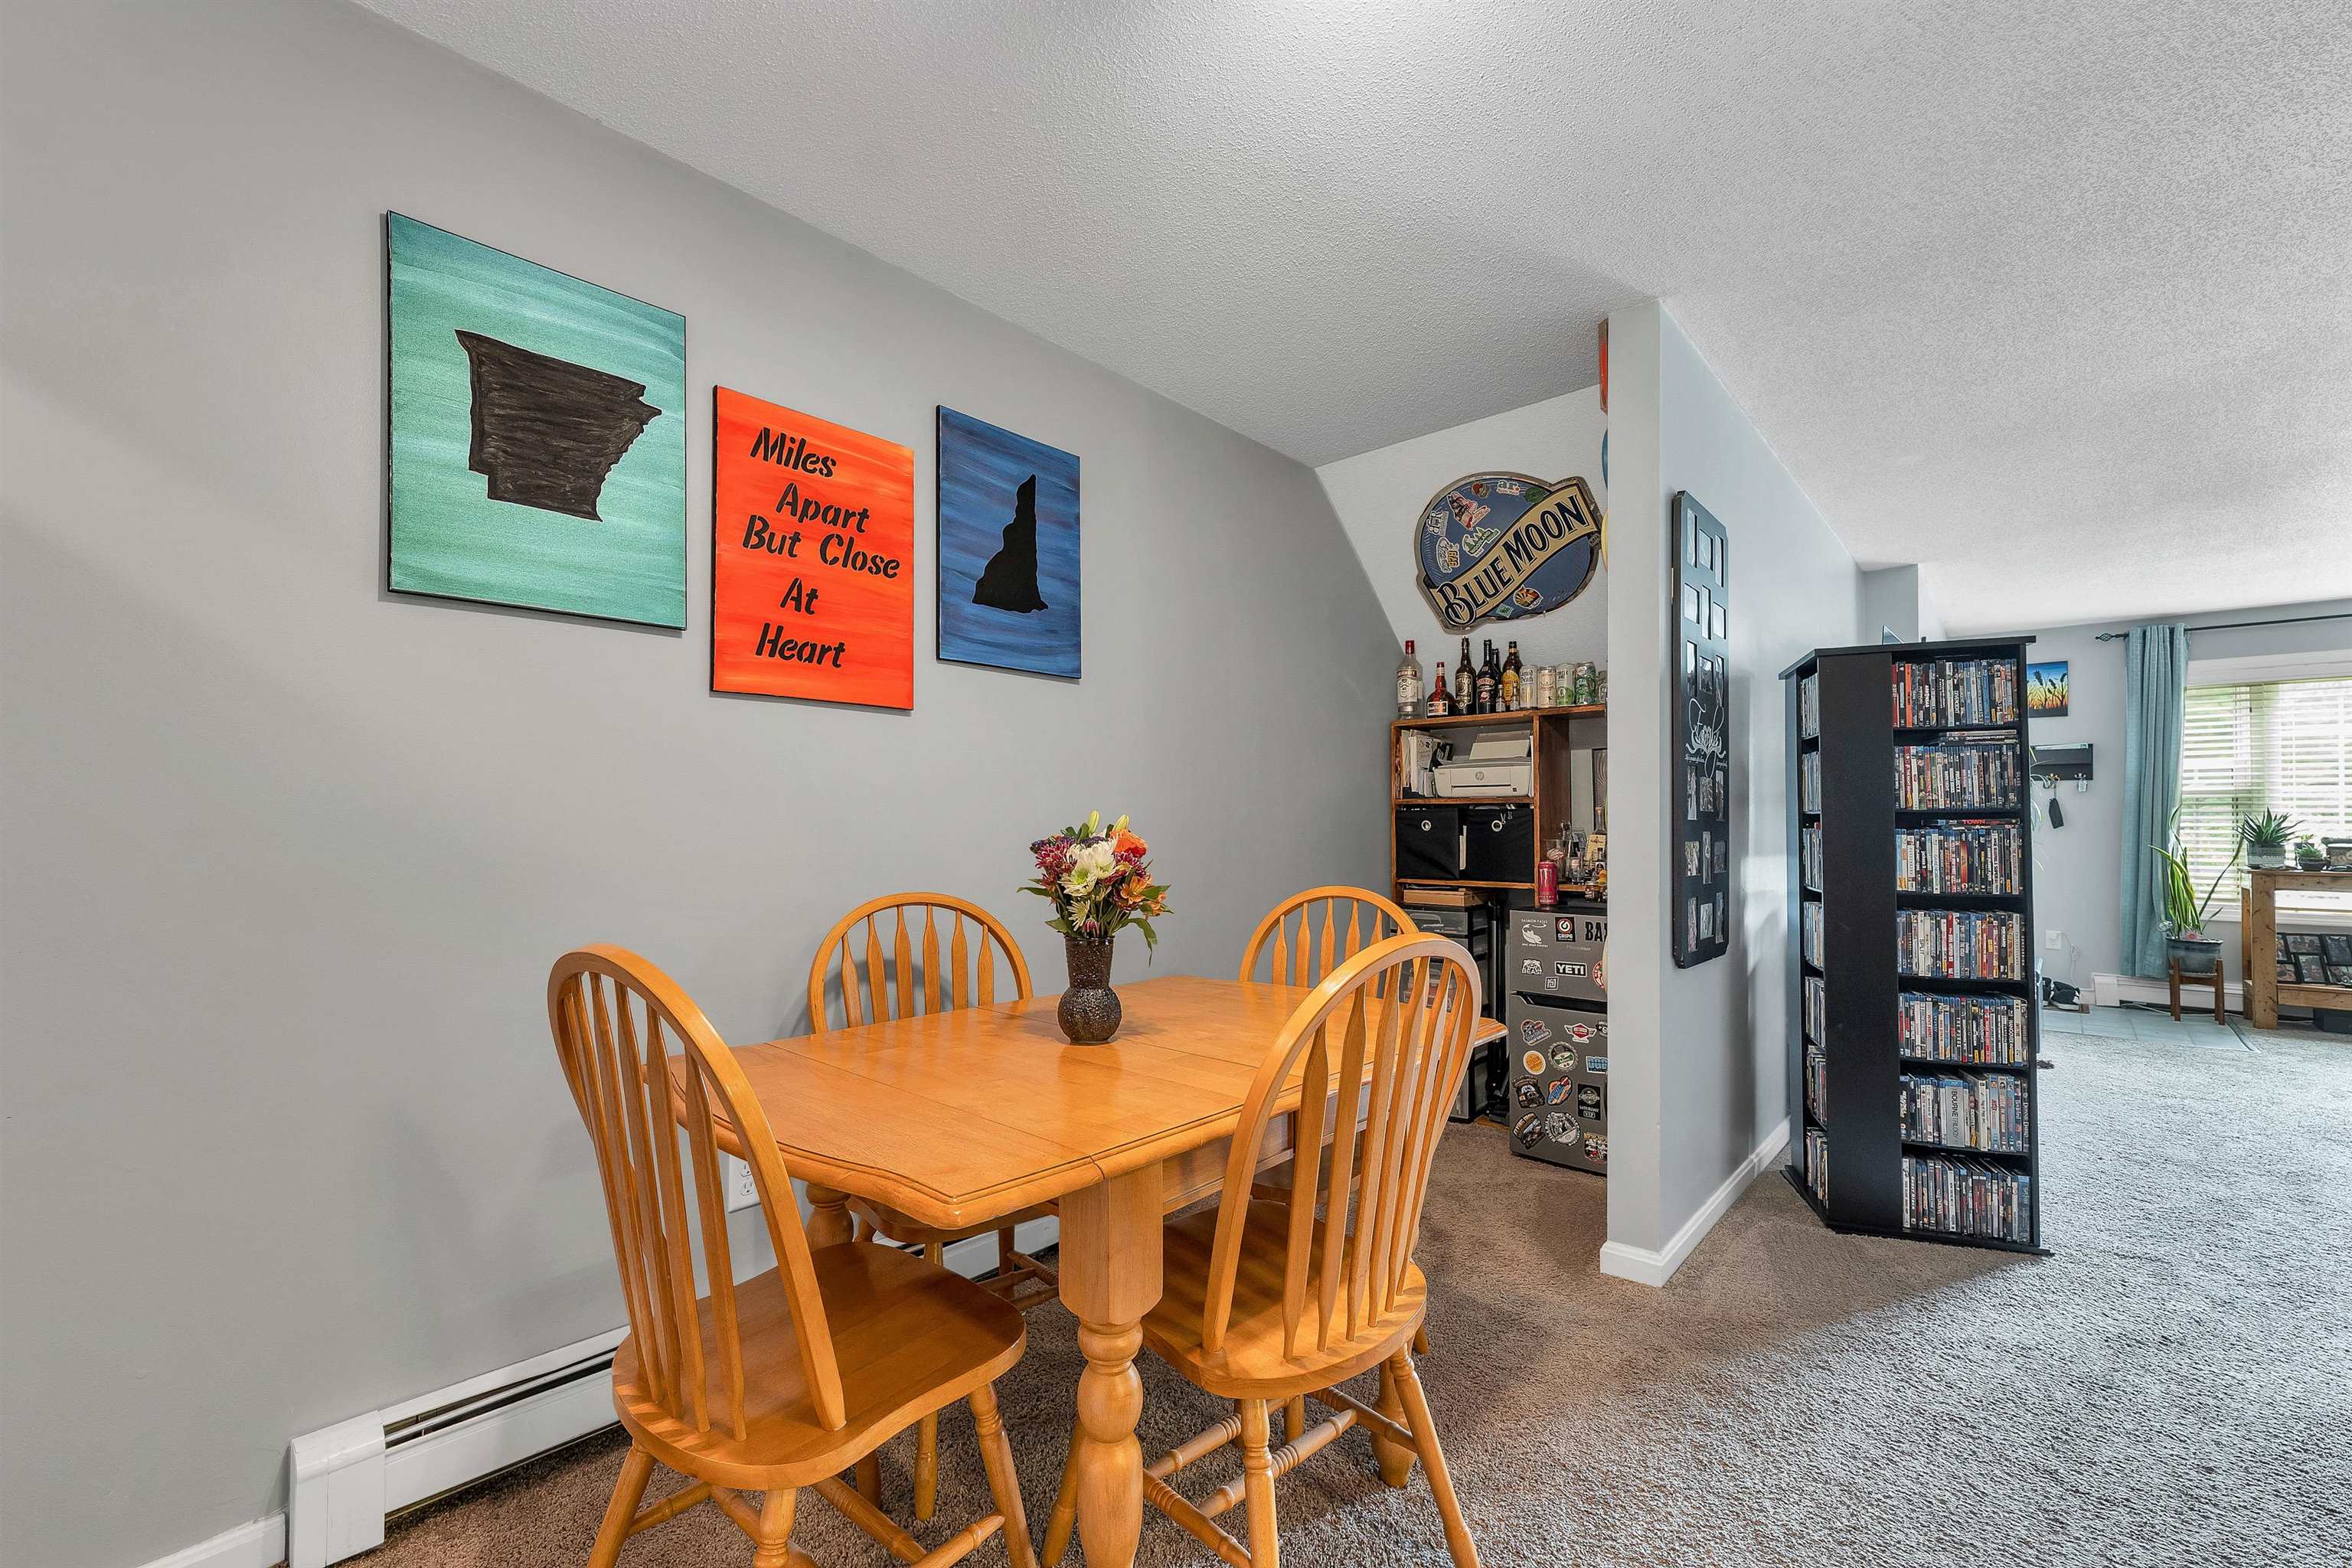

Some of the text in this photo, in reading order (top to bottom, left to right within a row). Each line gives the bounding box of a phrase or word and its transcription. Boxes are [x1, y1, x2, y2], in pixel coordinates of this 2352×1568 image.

[750, 426, 837, 479] Miles
[776, 482, 870, 534] Apart
[743, 514, 900, 579] But Close
[1436, 494, 1590, 626] BLUE MOON
[780, 577, 818, 616] At
[754, 622, 846, 668] Heart
[1557, 964, 1584, 975] YETI
